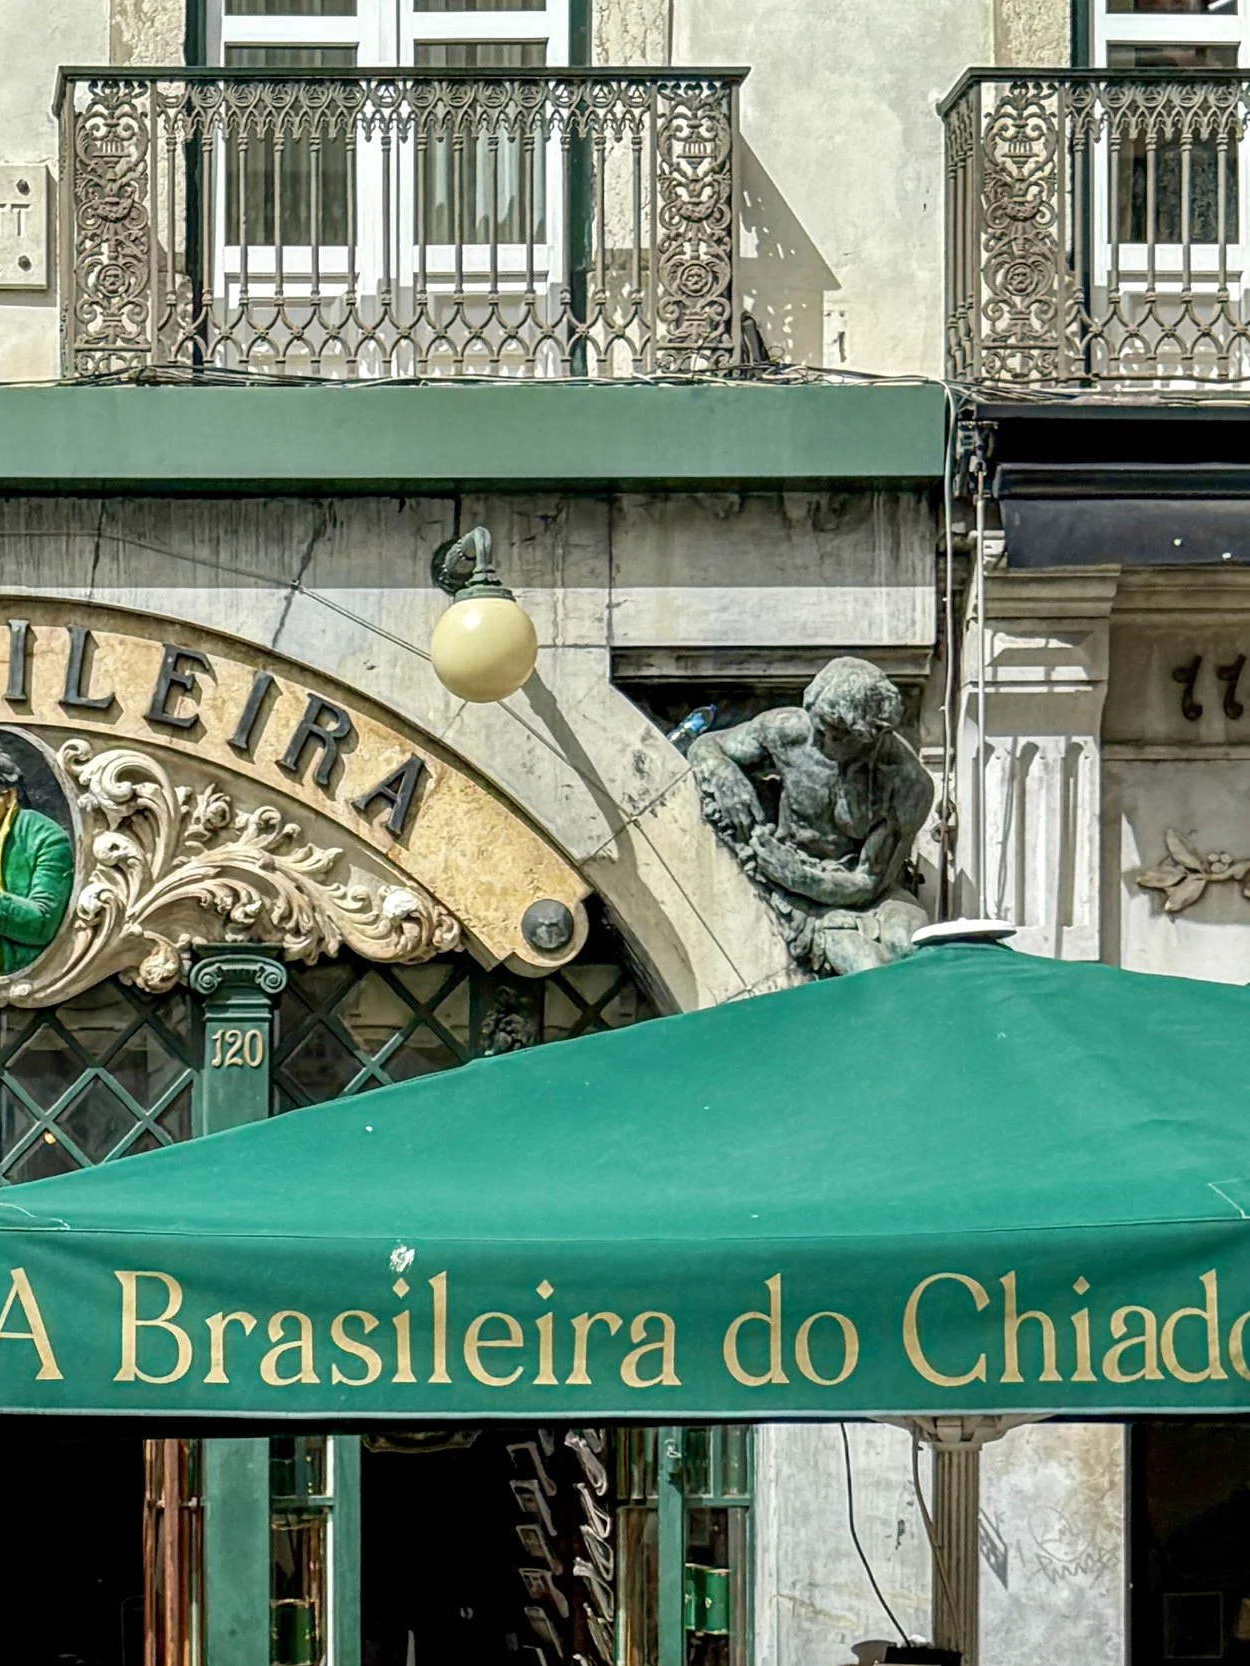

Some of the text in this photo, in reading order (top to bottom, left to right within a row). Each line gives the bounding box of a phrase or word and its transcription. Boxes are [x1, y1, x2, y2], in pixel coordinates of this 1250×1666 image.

[211, 1029, 264, 1067] 120
[113, 1269, 682, 1388] Brasileira
[722, 1272, 859, 1386] do
